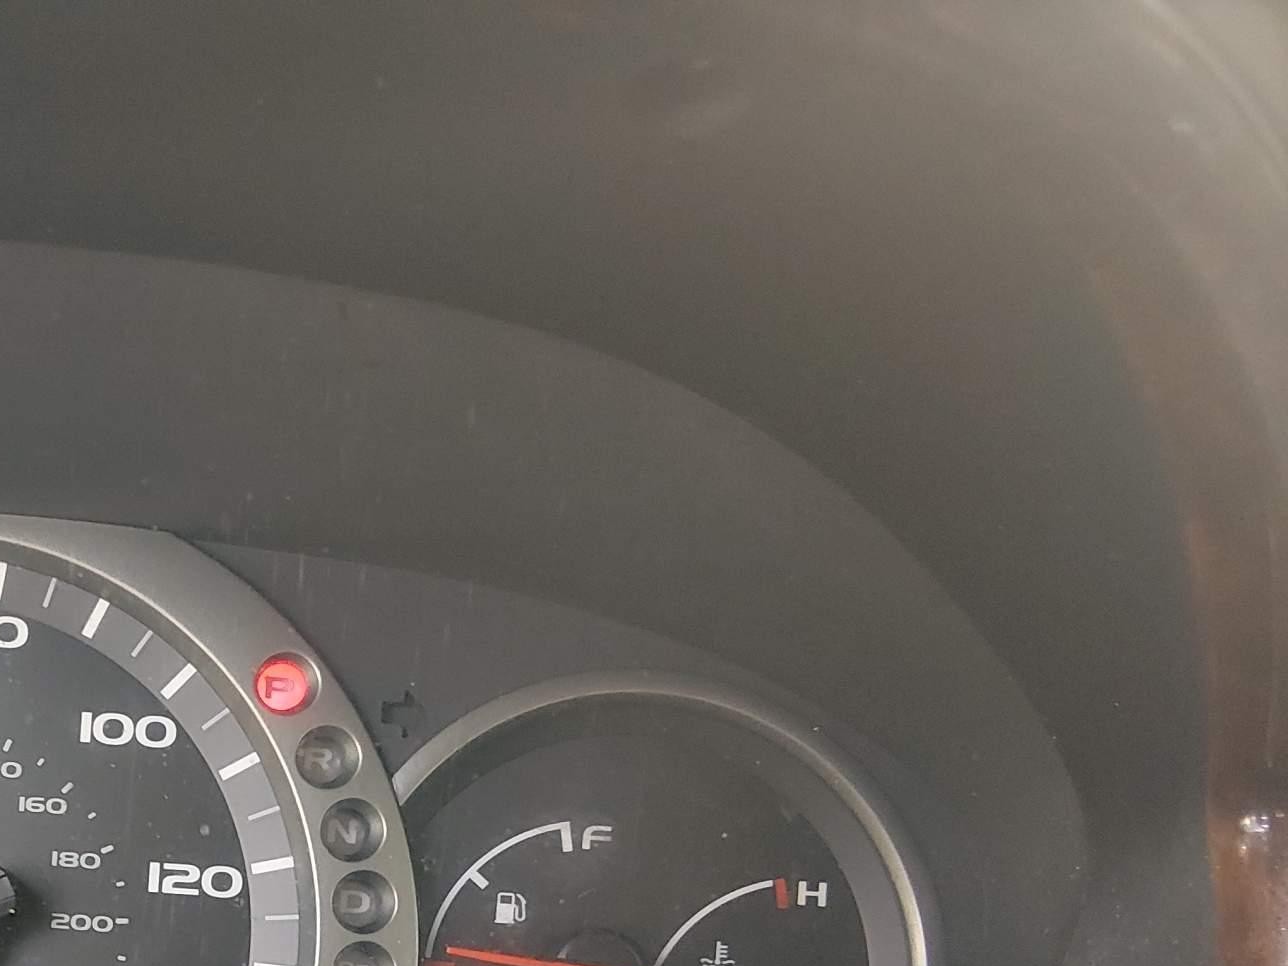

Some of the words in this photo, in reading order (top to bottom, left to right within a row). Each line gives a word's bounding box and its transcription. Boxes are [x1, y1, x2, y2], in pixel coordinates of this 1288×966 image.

[264, 675, 295, 699] P
[79, 711, 177, 748] 100
[18, 796, 68, 815] 160
[326, 817, 359, 844] N
[581, 824, 612, 850] F
[51, 850, 101, 870] 180
[147, 861, 243, 899] 120
[339, 890, 371, 915] D
[796, 880, 828, 907] H
[51, 913, 114, 933] 200
